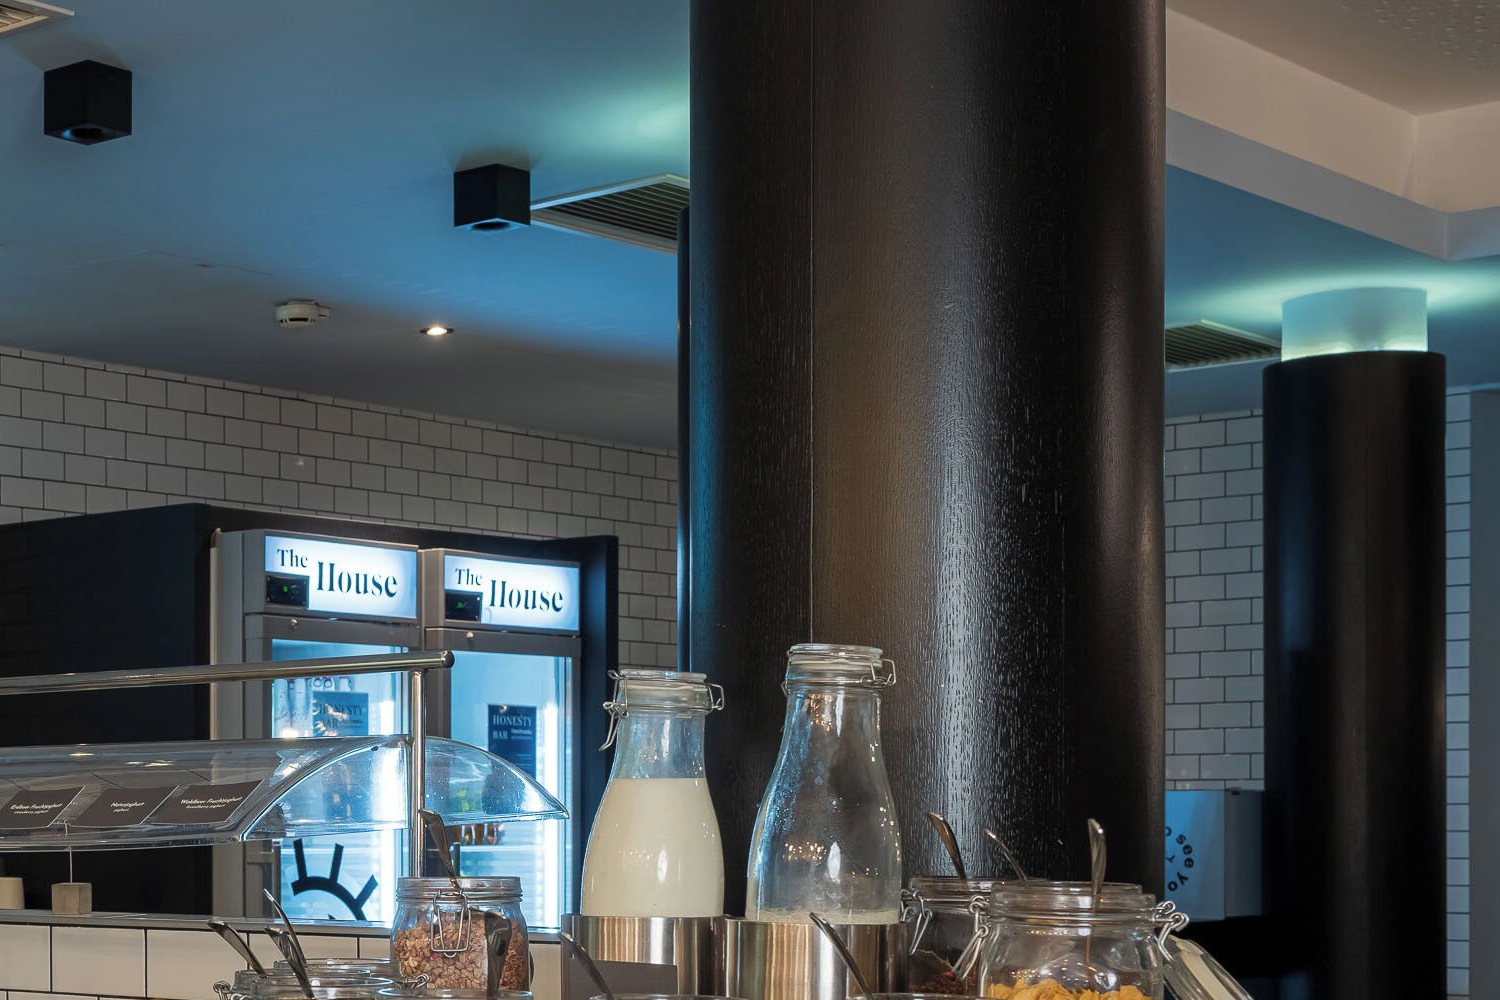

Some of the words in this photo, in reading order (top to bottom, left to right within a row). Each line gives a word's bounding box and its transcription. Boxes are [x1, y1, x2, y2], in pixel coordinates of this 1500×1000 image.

[277, 547, 309, 569] The
[316, 561, 398, 599] House
[454, 567, 483, 588] The
[489, 579, 565, 613] House
[492, 714, 533, 727] HONESTY
[1176, 834, 1195, 869] see
[1167, 871, 1189, 892] yo
